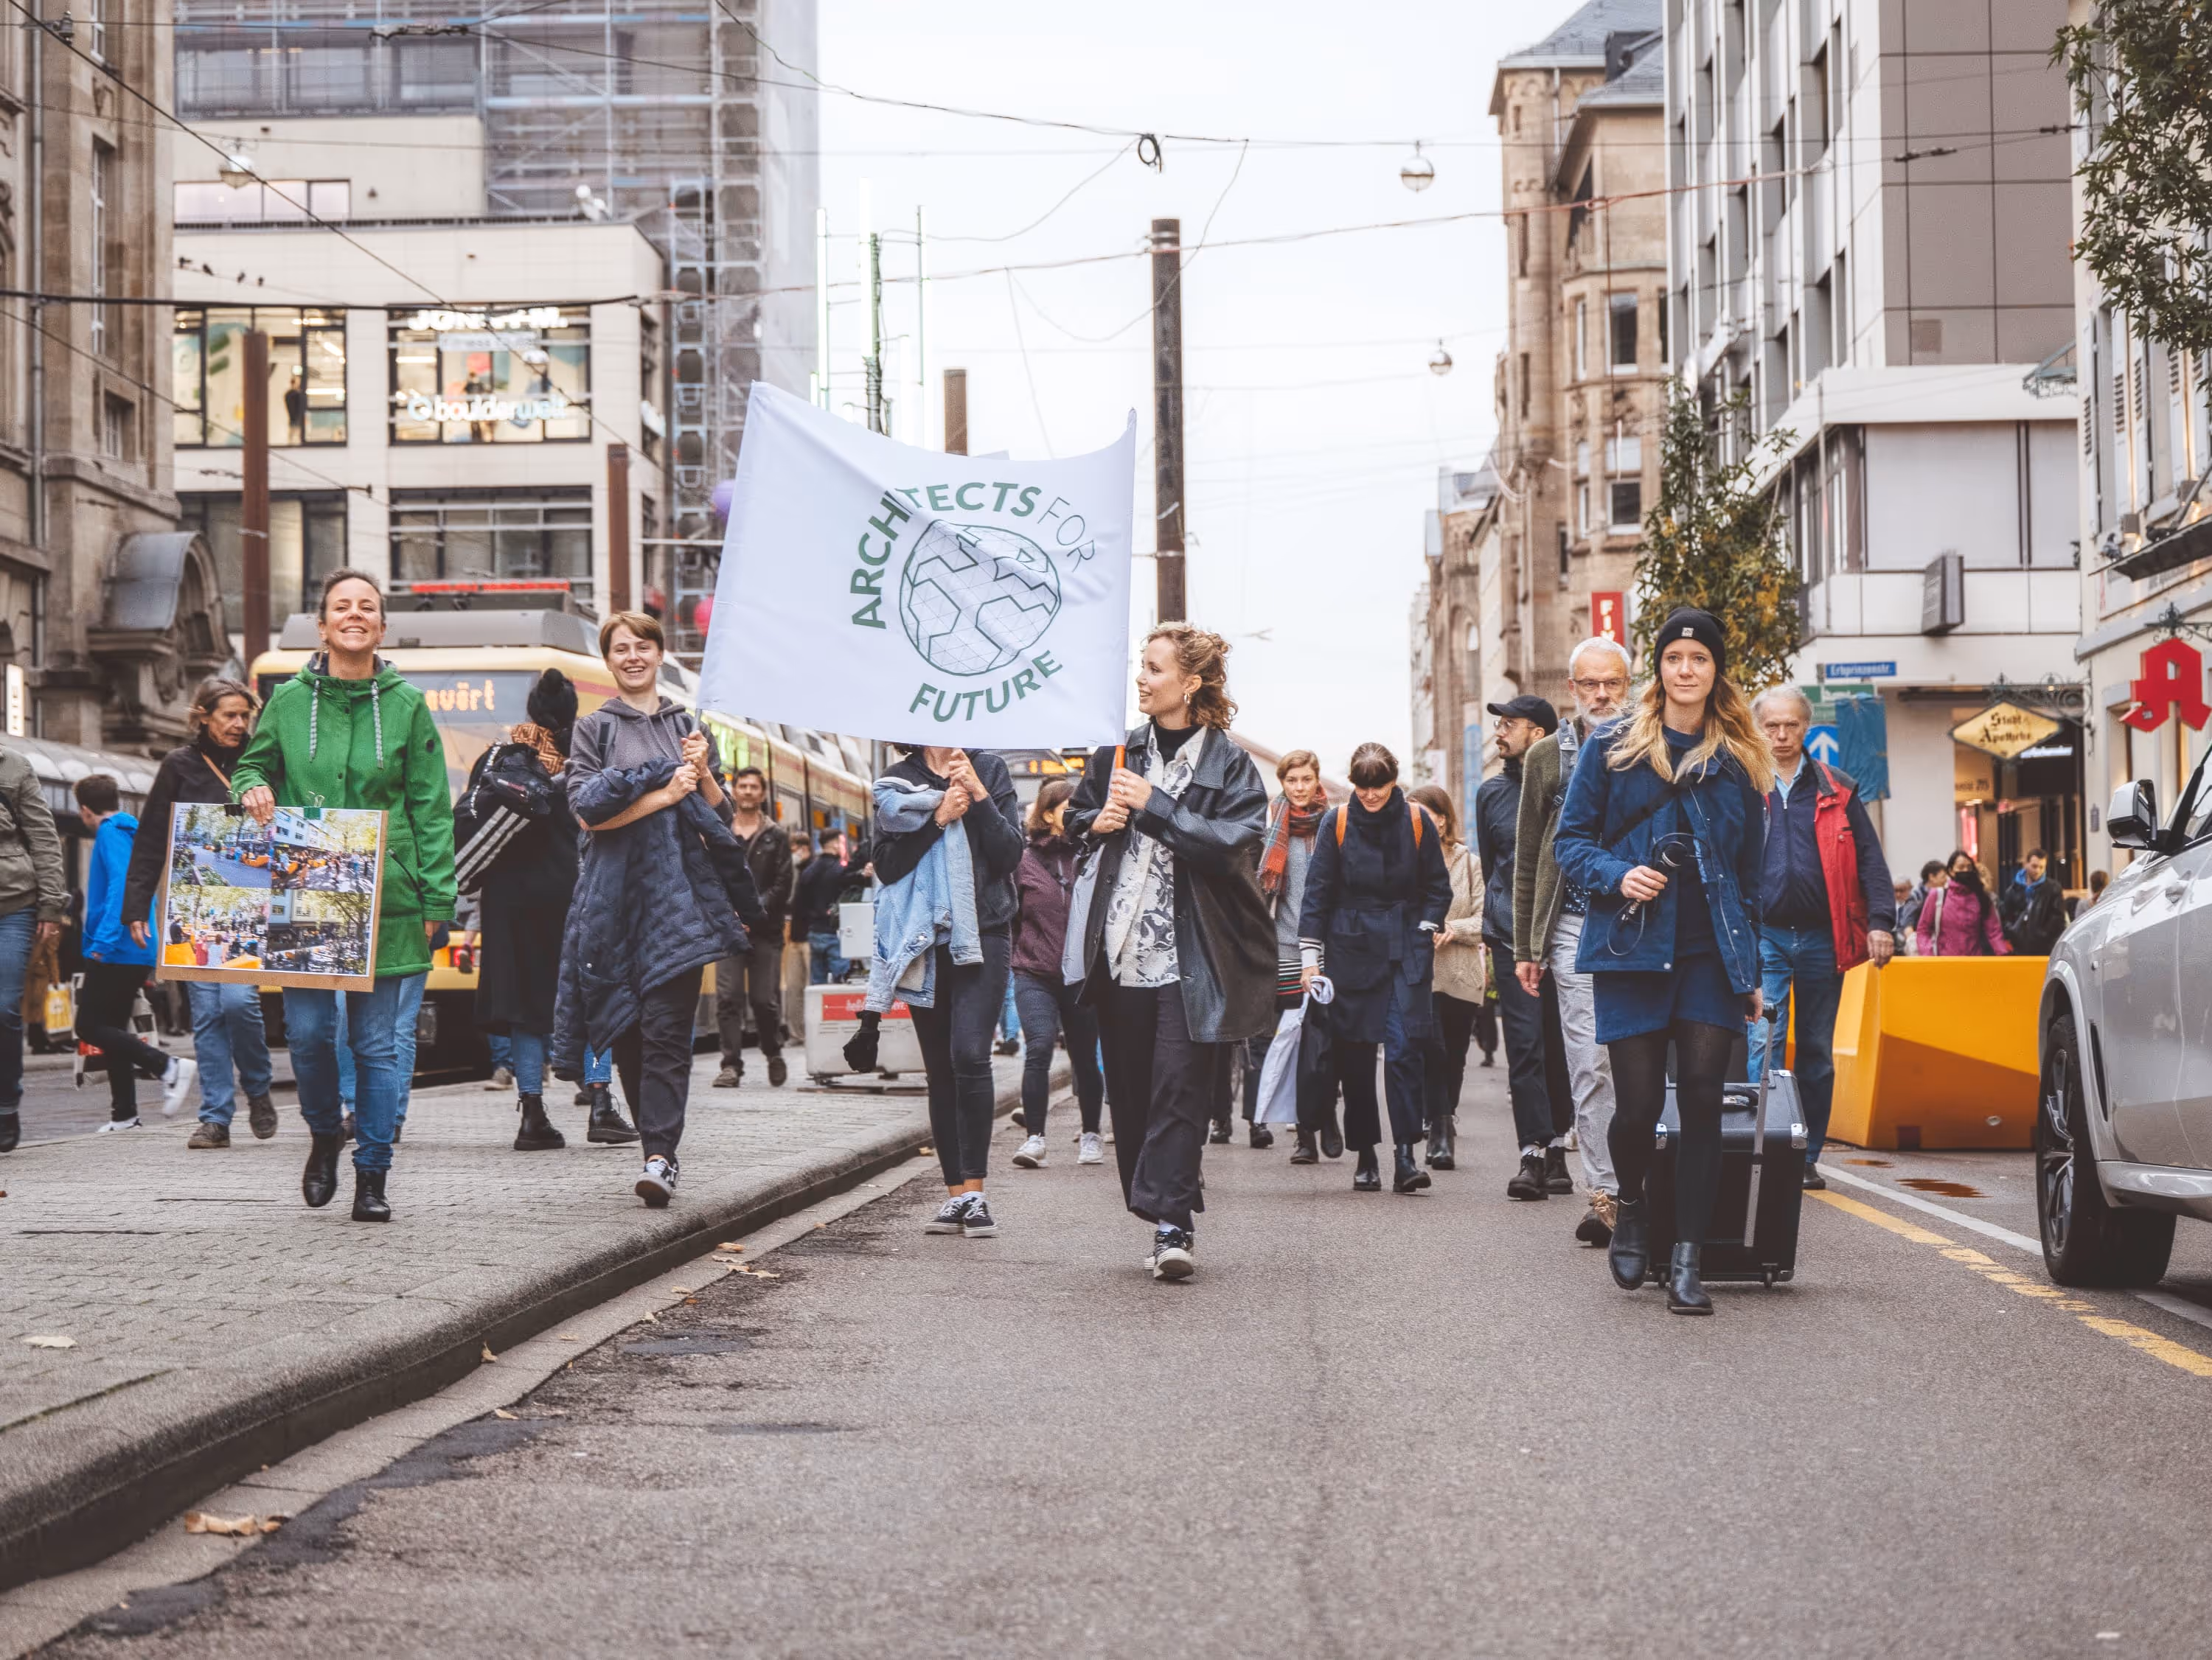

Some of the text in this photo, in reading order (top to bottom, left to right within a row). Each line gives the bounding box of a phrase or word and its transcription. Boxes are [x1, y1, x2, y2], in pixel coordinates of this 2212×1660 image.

[850, 482, 1095, 722] ARCHITECTS FOR FUTURE
